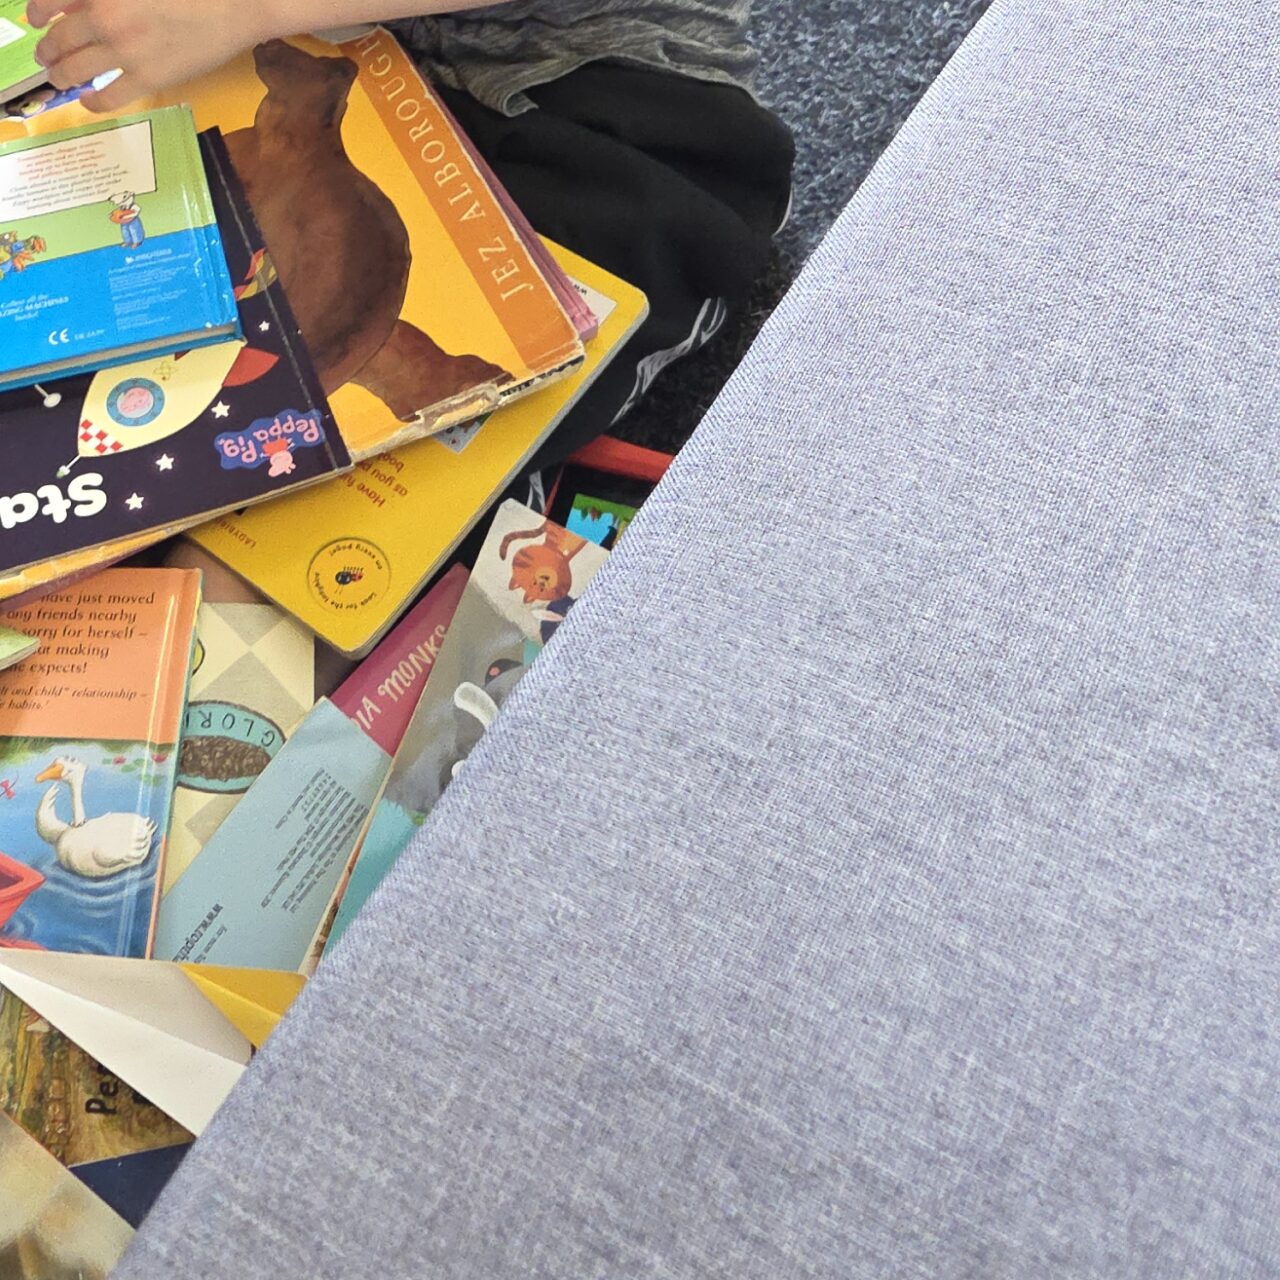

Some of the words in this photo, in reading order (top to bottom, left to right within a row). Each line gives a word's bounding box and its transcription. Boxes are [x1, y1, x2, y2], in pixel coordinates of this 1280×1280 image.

[356, 35, 488, 222] ALBOROUGH
[475, 235, 535, 302] JEZ
[254, 417, 321, 443] Peppa
[370, 468, 394, 489] you
[362, 483, 387, 508] Have
[392, 484, 409, 498] as
[76, 592, 104, 606] just
[107, 591, 156, 605] moved
[7, 610, 33, 623] any
[36, 608, 84, 621] friends
[88, 610, 138, 624] nearby
[21, 628, 59, 640] sorry
[61, 625, 84, 642] for
[87, 626, 137, 639] herself
[55, 644, 110, 659] making
[29, 662, 89, 676] expects!
[71, 687, 138, 702] relationship
